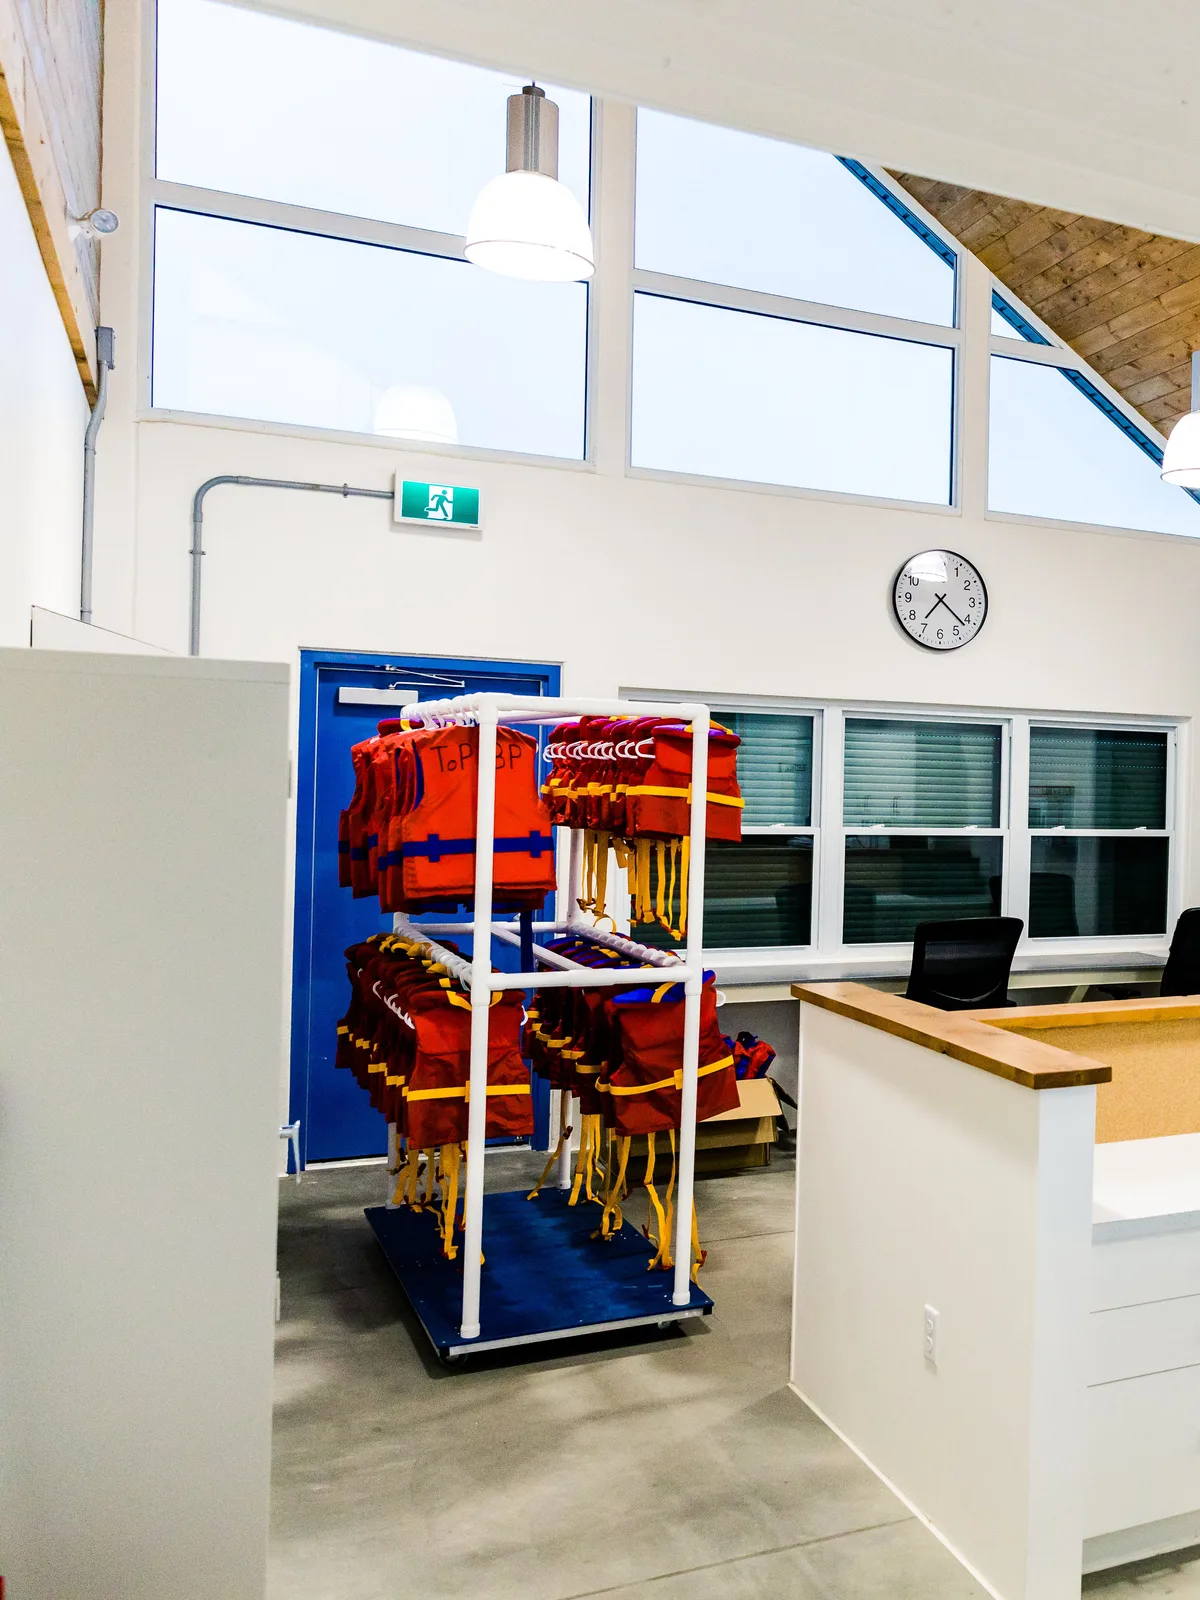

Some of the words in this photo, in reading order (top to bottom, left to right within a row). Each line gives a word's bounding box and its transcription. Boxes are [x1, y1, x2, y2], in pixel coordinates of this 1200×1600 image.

[953, 567, 959, 577] 1
[907, 575, 919, 586] 10
[963, 580, 971, 591] 2
[904, 592, 912, 603] 9
[968, 597, 976, 608] 3
[908, 609, 916, 620] 8
[964, 614, 971, 624] 4
[920, 623, 928, 633] 7
[952, 625, 960, 636] 5
[936, 629, 944, 639] 6
